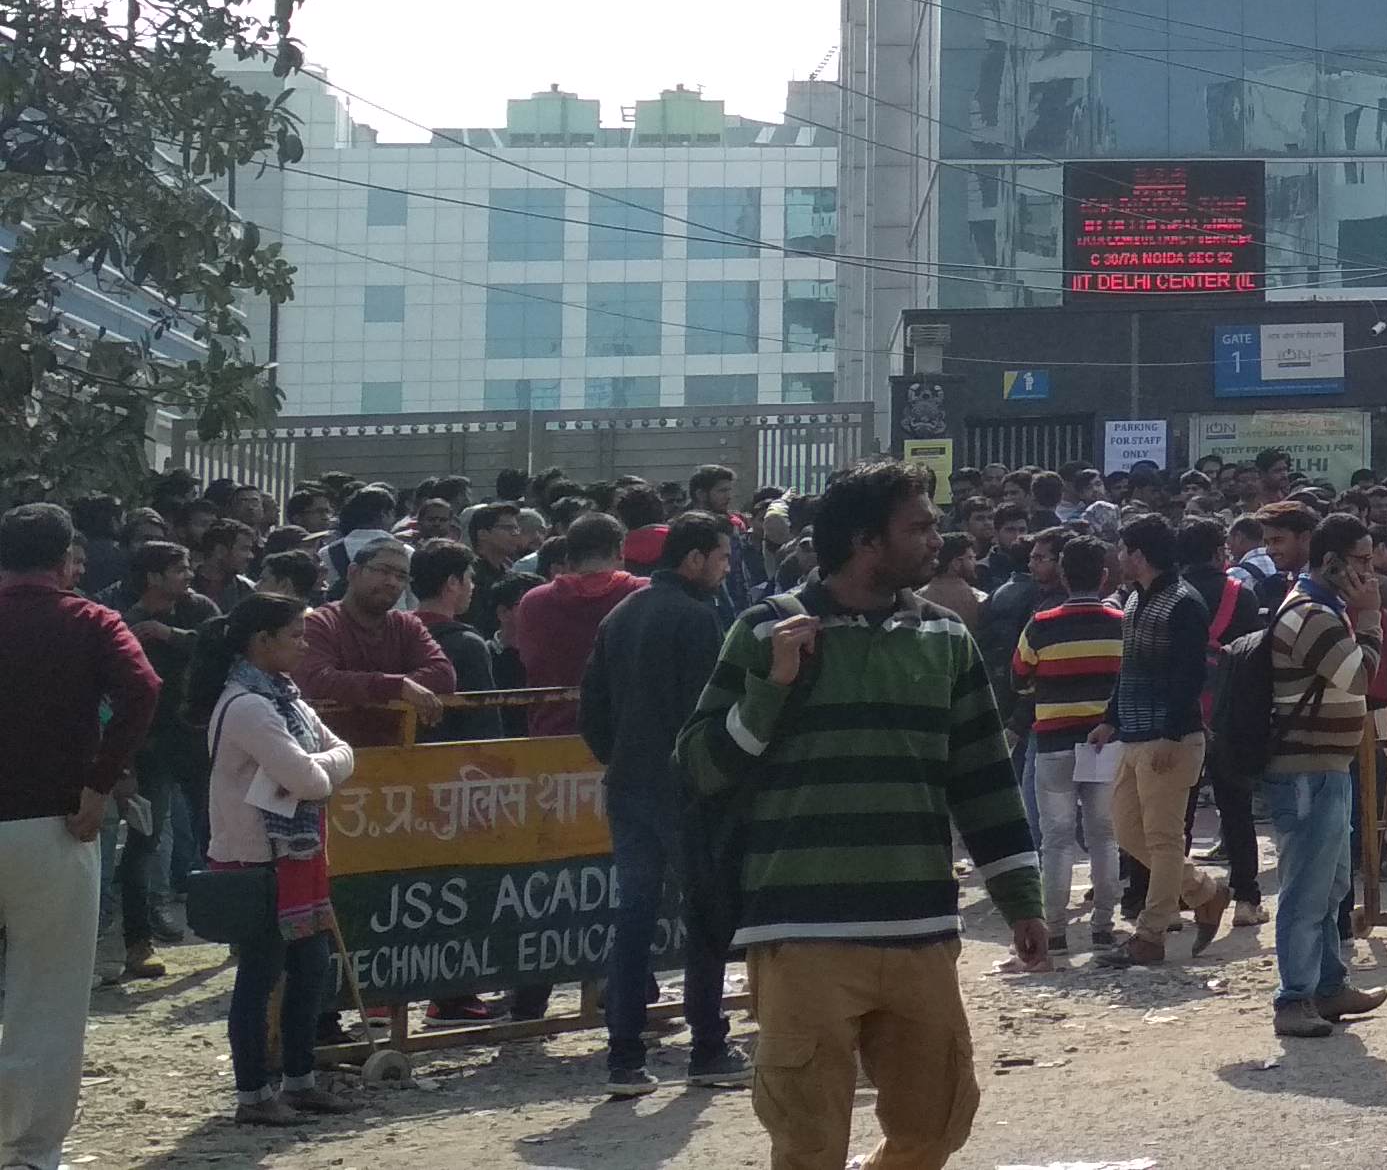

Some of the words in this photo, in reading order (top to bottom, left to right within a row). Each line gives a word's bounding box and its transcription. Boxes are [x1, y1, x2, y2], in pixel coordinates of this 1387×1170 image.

[1142, 252, 1184, 265] NOIDA
[1099, 273, 1150, 290] DELHI
[1156, 272, 1230, 289] CENTER
[1222, 333, 1252, 345] GATE
[1231, 350, 1241, 374] 1
[1114, 423, 1159, 432] PARKING
[1110, 436, 1129, 446] FOR
[1131, 436, 1161, 445] STAFF
[1122, 450, 1150, 459] ONLY
[1211, 446, 1244, 455] ENTRY
[1277, 444, 1305, 453] GATE
[1333, 443, 1354, 452] FOR
[1288, 457, 1328, 472] ELHI
[535, 771, 608, 824] थान
[370, 877, 469, 933] JSS
[492, 864, 621, 923] ACADE
[328, 936, 500, 995] TECHNICAL
